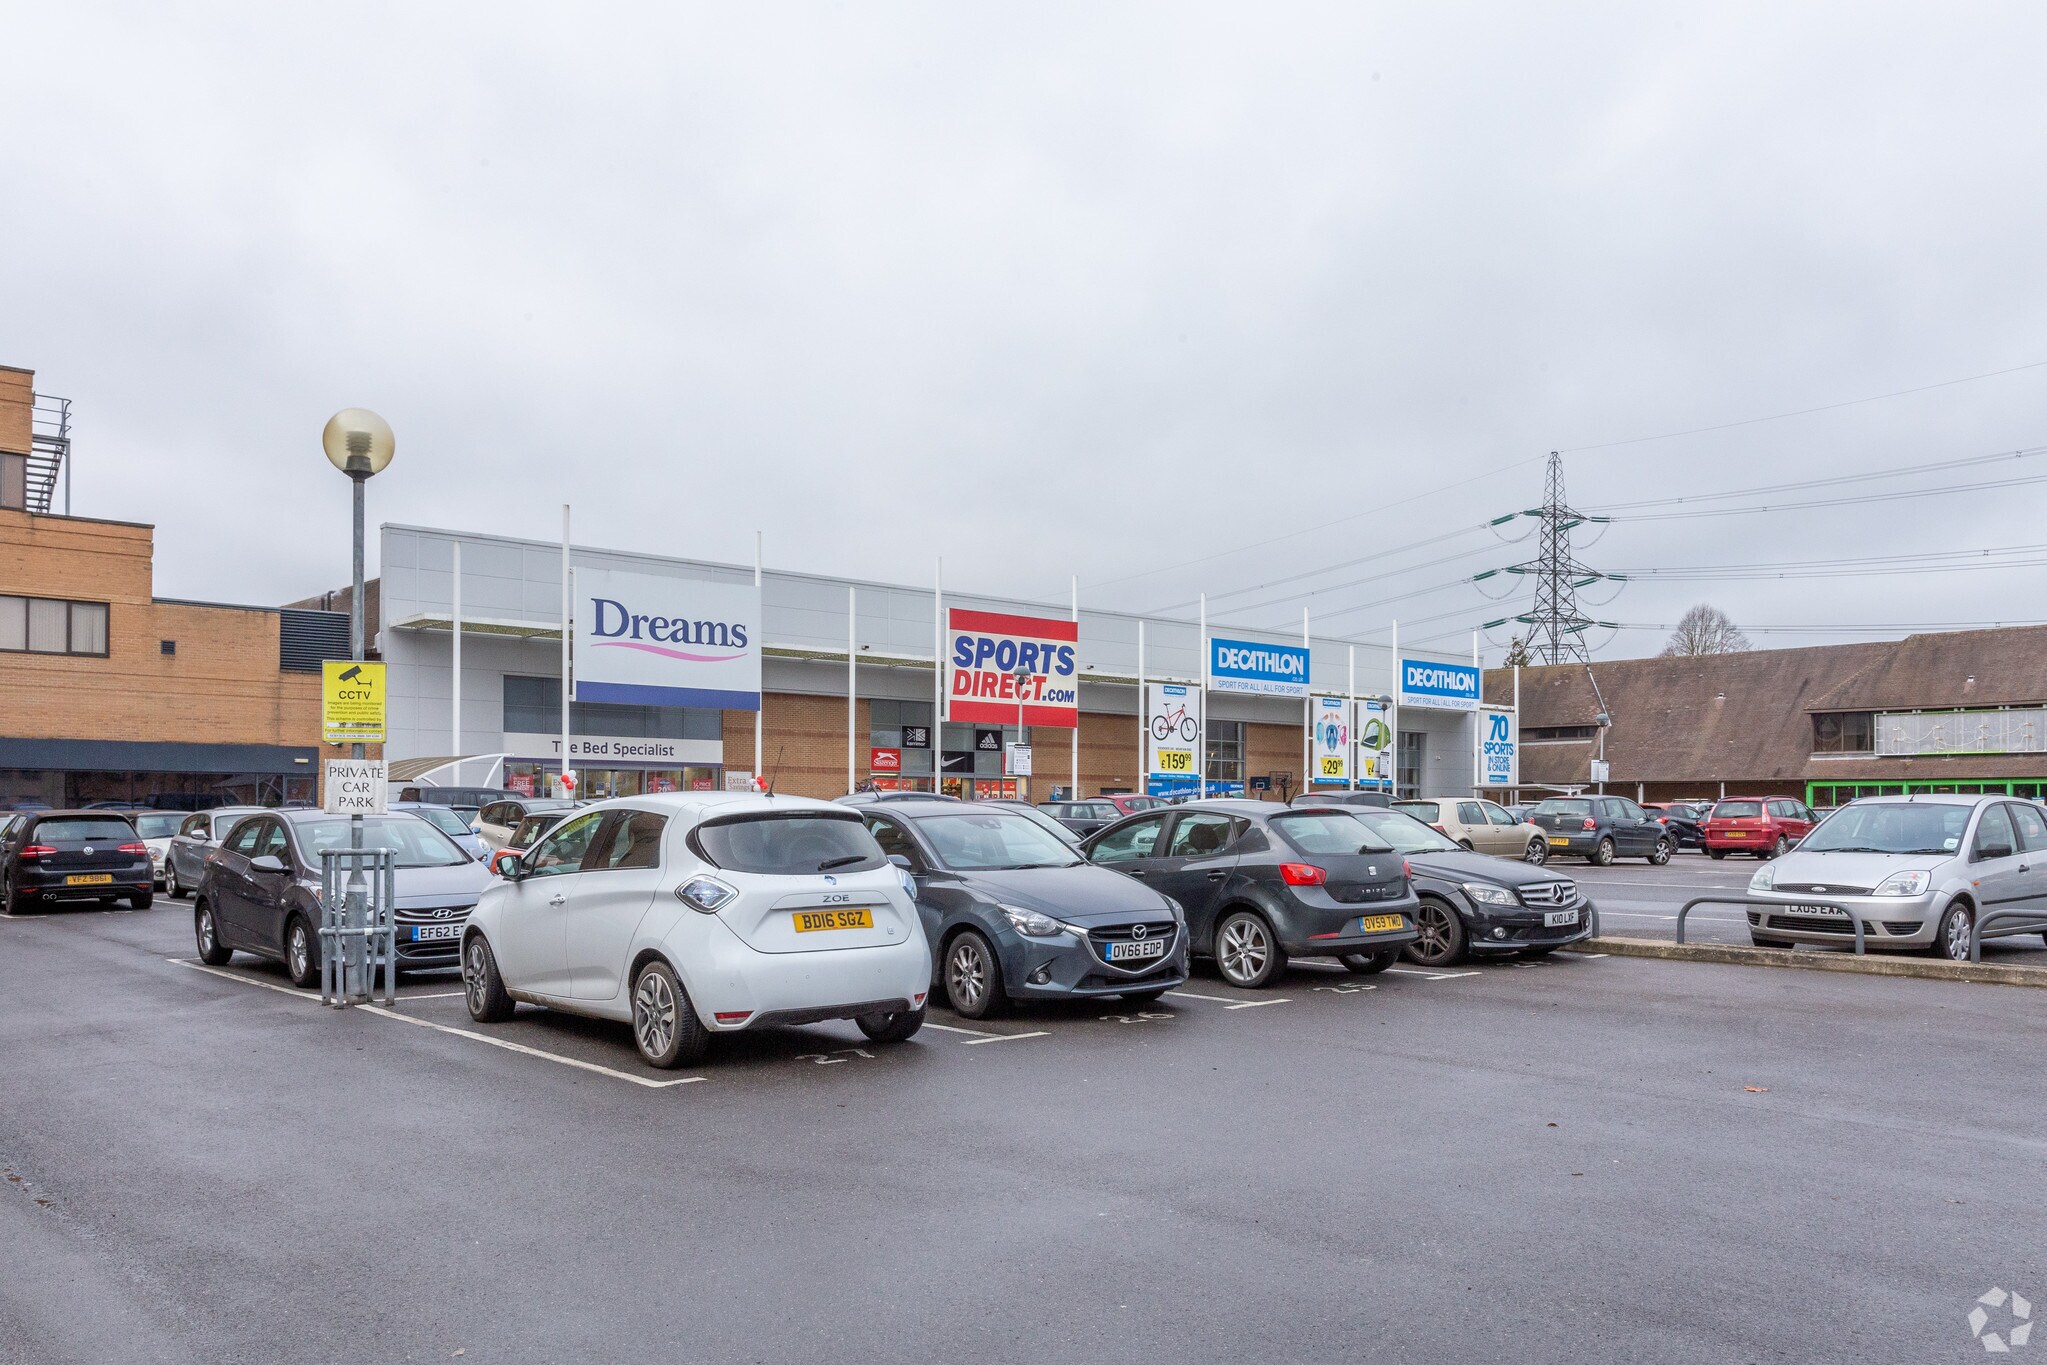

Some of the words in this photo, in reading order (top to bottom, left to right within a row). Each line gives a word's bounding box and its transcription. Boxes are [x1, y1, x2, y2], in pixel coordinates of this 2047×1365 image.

[590, 597, 748, 649] Dreams
[952, 635, 1075, 676] SPORTS
[1218, 646, 1304, 676] DECATHLON
[1407, 667, 1475, 692] DECATHLON
[1218, 680, 1236, 689] SPORT
[1238, 682, 1248, 690] FOR
[1250, 683, 1260, 691] ALL
[1264, 684, 1274, 692] ALL
[1274, 685, 1286, 693] FOR
[1286, 686, 1304, 694] SPORT
[338, 690, 370, 700] CCTV
[1489, 714, 1509, 742] 70
[552, 740, 578, 753] Te
[583, 742, 608, 754] Bed
[613, 743, 674, 757] Specialist
[1484, 742, 1514, 756] SPORTS
[1492, 764, 1510, 772] ONLINE
[1494, 757, 1509, 765] STORE
[330, 766, 383, 778] PRIVATE
[342, 782, 370, 792] CAR
[339, 797, 374, 807] PARK
[1790, 905, 1817, 913] LX05
[802, 913, 834, 929] BD16
[838, 912, 865, 926] SGZ
[1365, 917, 1386, 929] OV59
[421, 926, 450, 938] EF62
[1114, 944, 1141, 958] OV66
[1144, 942, 1161, 955] EDP
